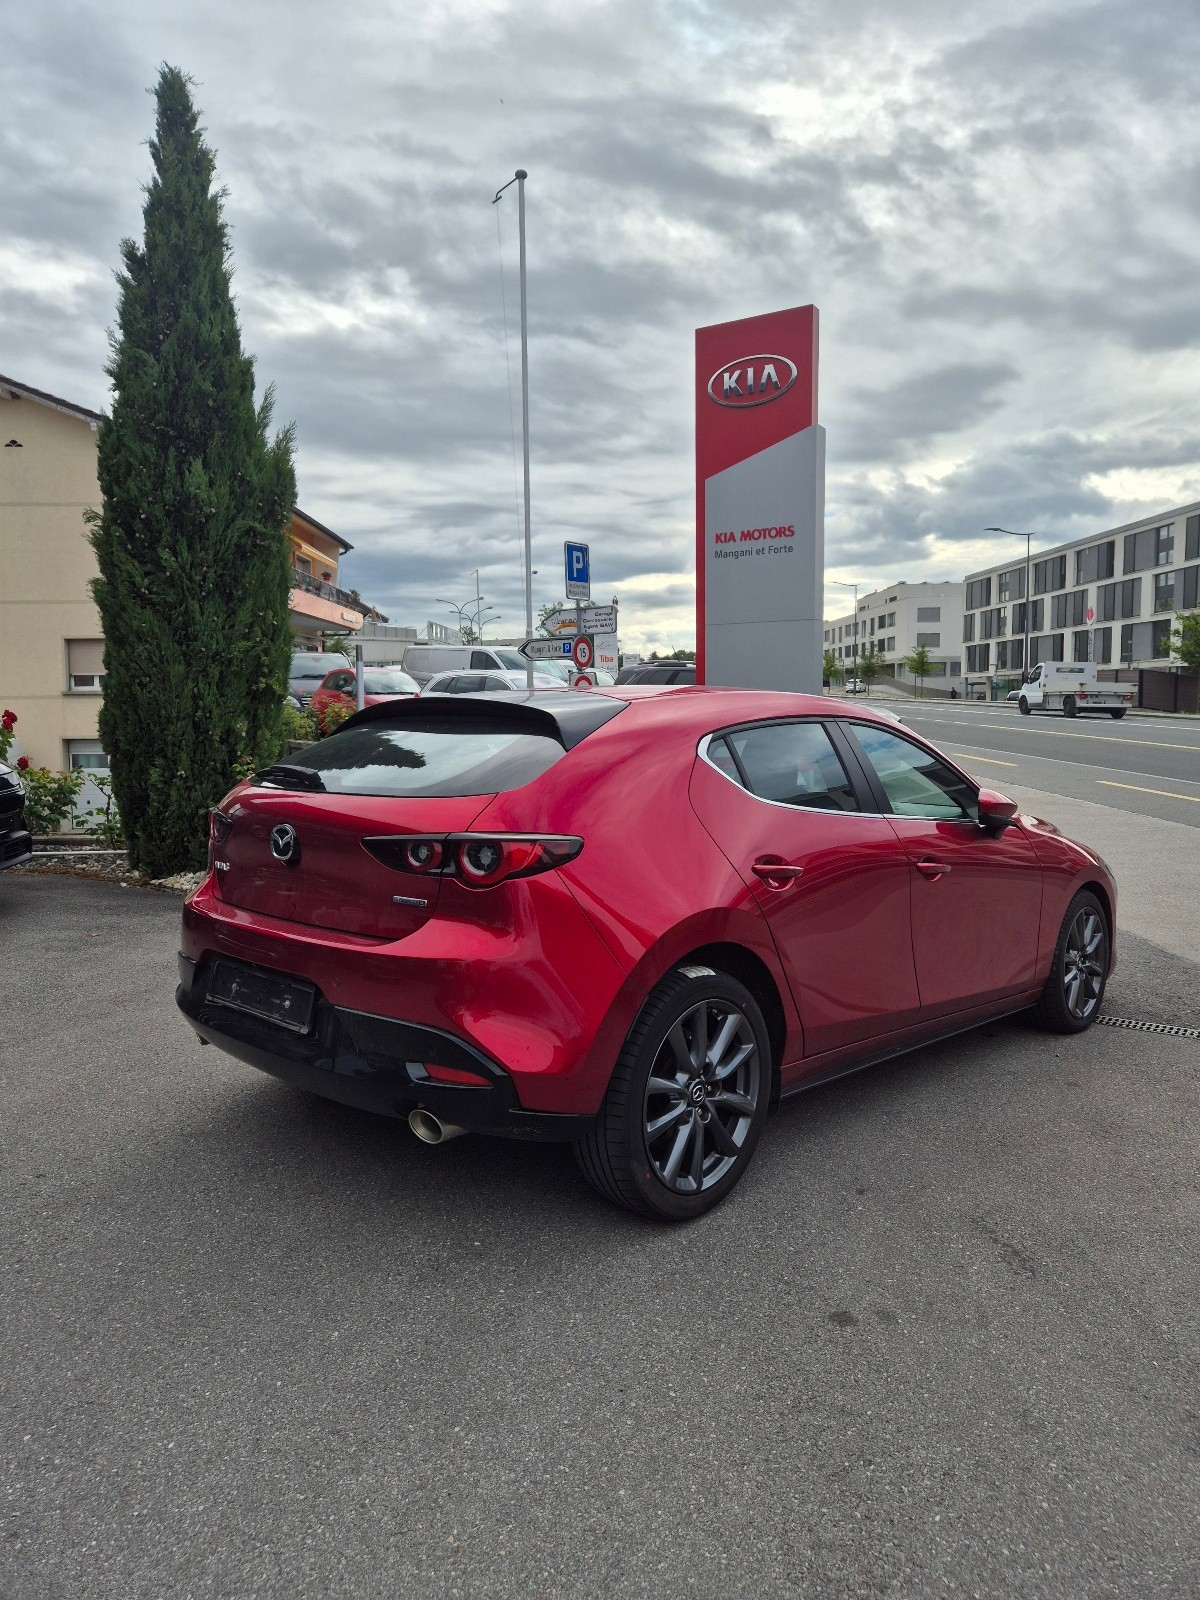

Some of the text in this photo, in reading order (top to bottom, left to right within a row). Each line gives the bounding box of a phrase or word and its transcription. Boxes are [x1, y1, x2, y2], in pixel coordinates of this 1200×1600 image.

[722, 363, 781, 398] KIA
[715, 525, 794, 544] KIA MOTORS
[714, 543, 794, 560] Mangani et Forte
[572, 551, 583, 577] P
[580, 647, 587, 658] 15
